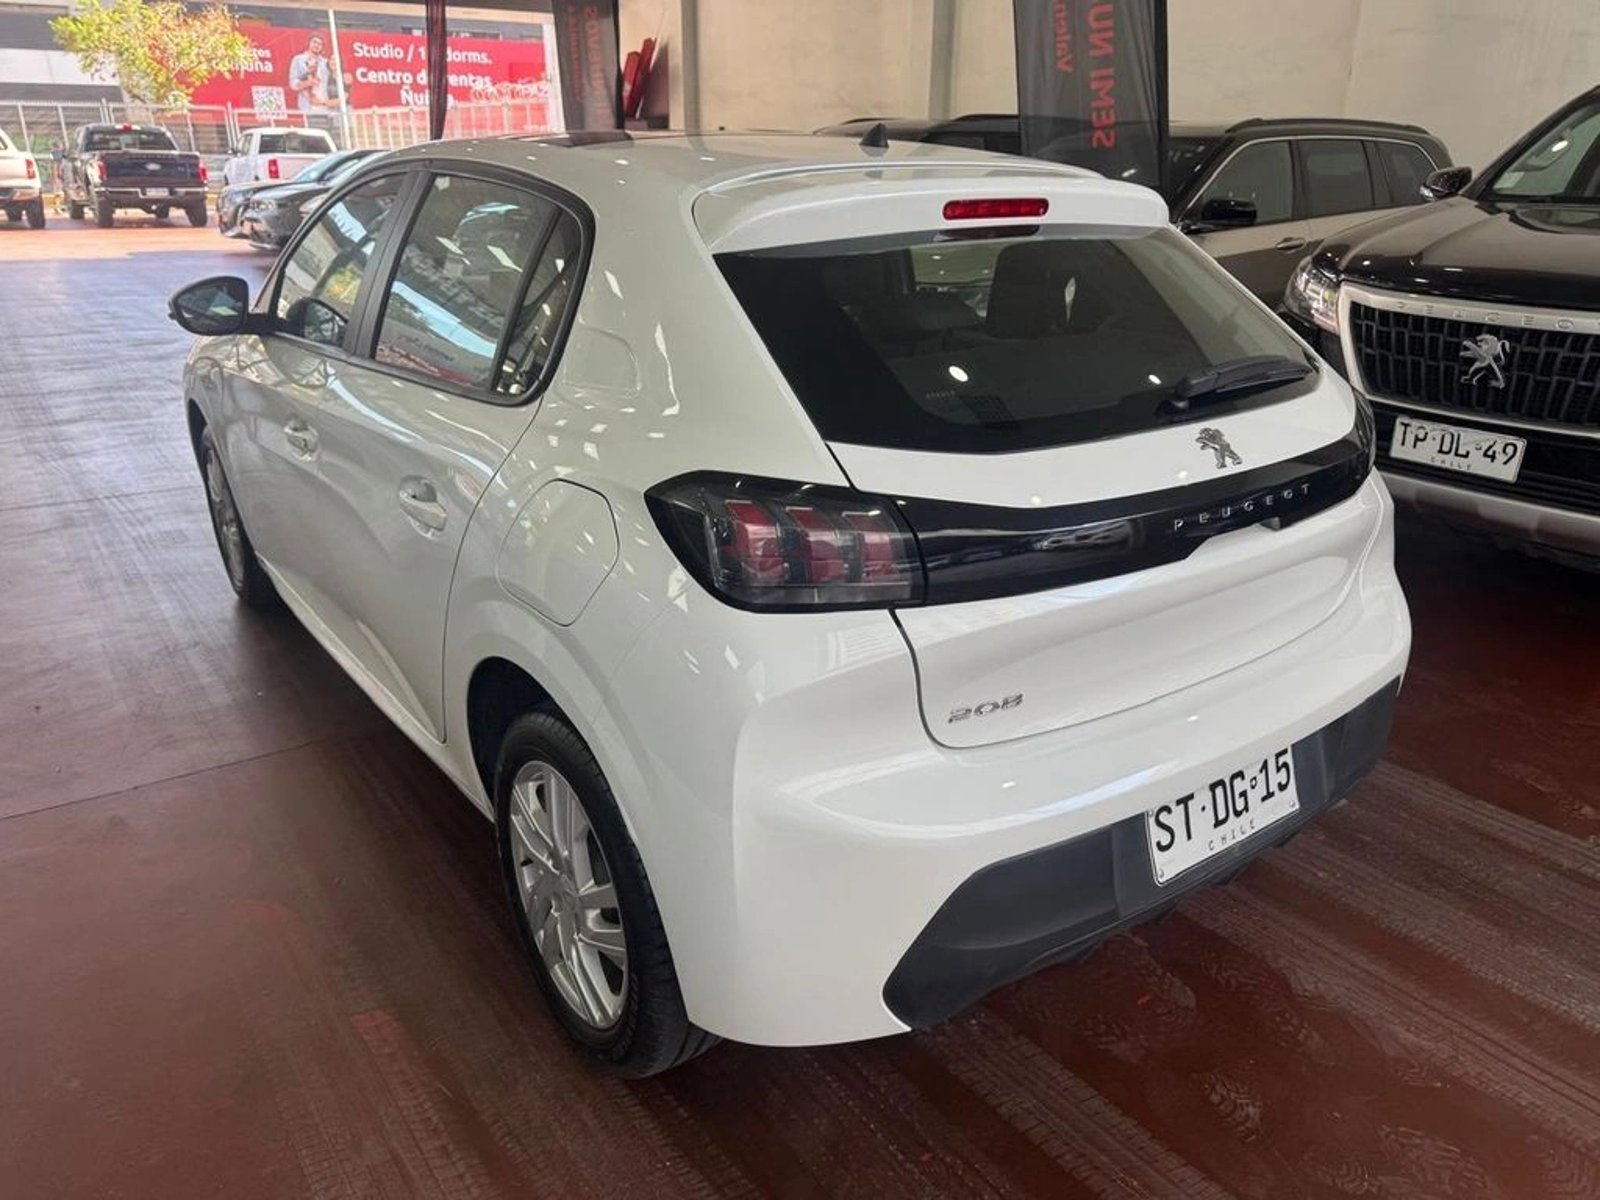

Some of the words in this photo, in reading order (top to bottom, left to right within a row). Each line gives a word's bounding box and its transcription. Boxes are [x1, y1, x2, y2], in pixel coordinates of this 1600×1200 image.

[353, 42, 404, 59] Studio
[355, 67, 413, 85] Centro
[416, 68, 428, 85] d
[446, 72, 492, 91] entas
[1393, 300, 1600, 330] PEUGEO
[1174, 483, 1310, 532] PEUGEOT
[948, 693, 1024, 724] 208
[1208, 817, 1256, 851] CHILE
